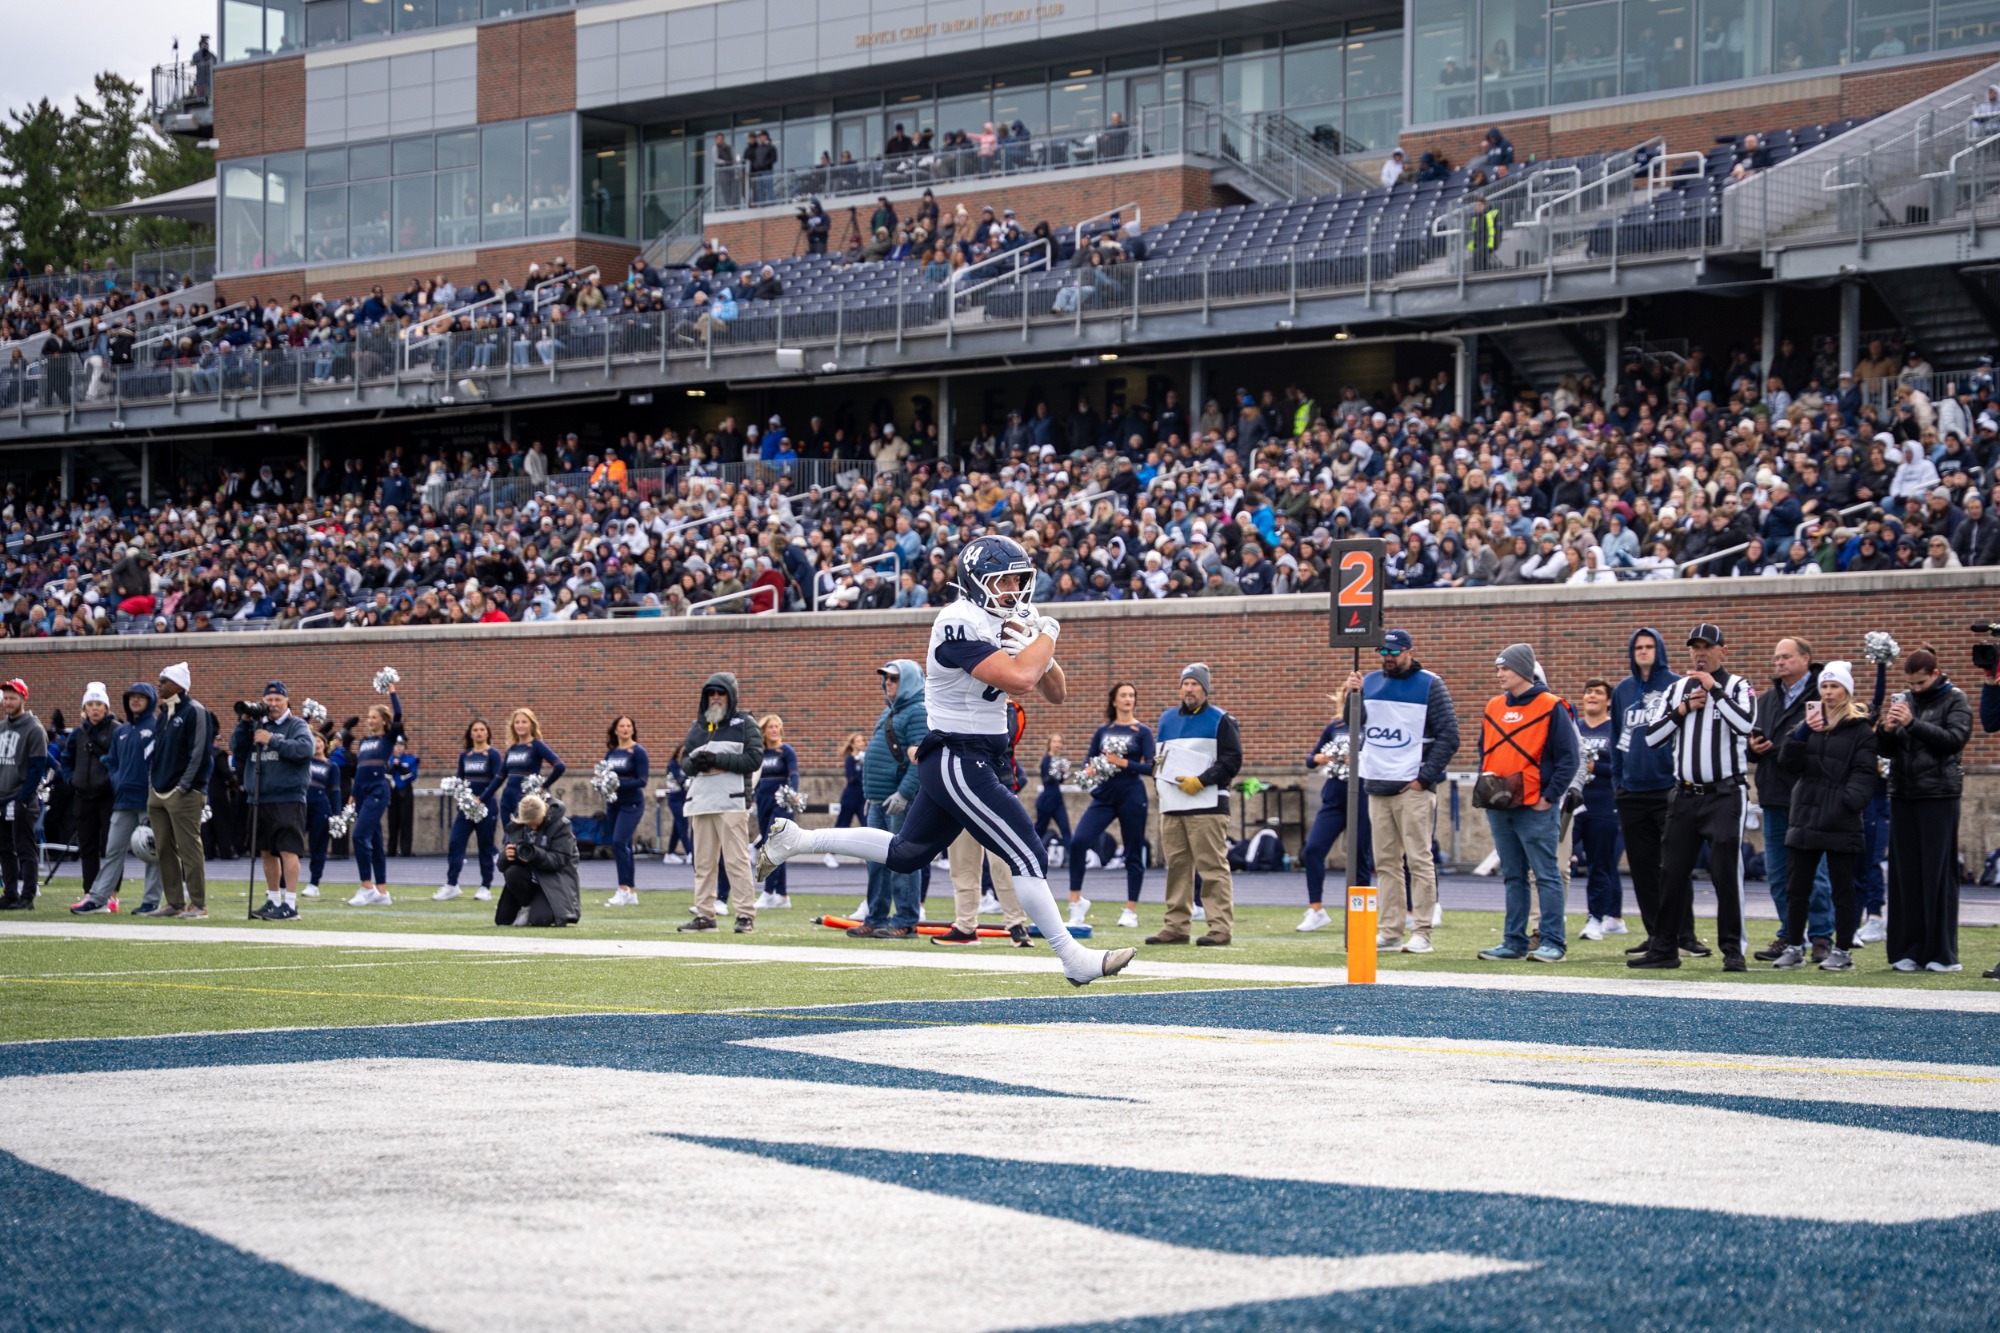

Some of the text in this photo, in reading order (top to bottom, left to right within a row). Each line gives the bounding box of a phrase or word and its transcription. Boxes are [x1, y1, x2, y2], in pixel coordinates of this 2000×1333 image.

[855, 3, 1065, 49] SERVICE CREDIT UNION VICTORY CLUB
[963, 546, 984, 565] 84
[1338, 550, 1374, 606] 2
[944, 624, 967, 641] 84
[1713, 709, 1721, 720] H
[1366, 726, 1403, 742] CAA
